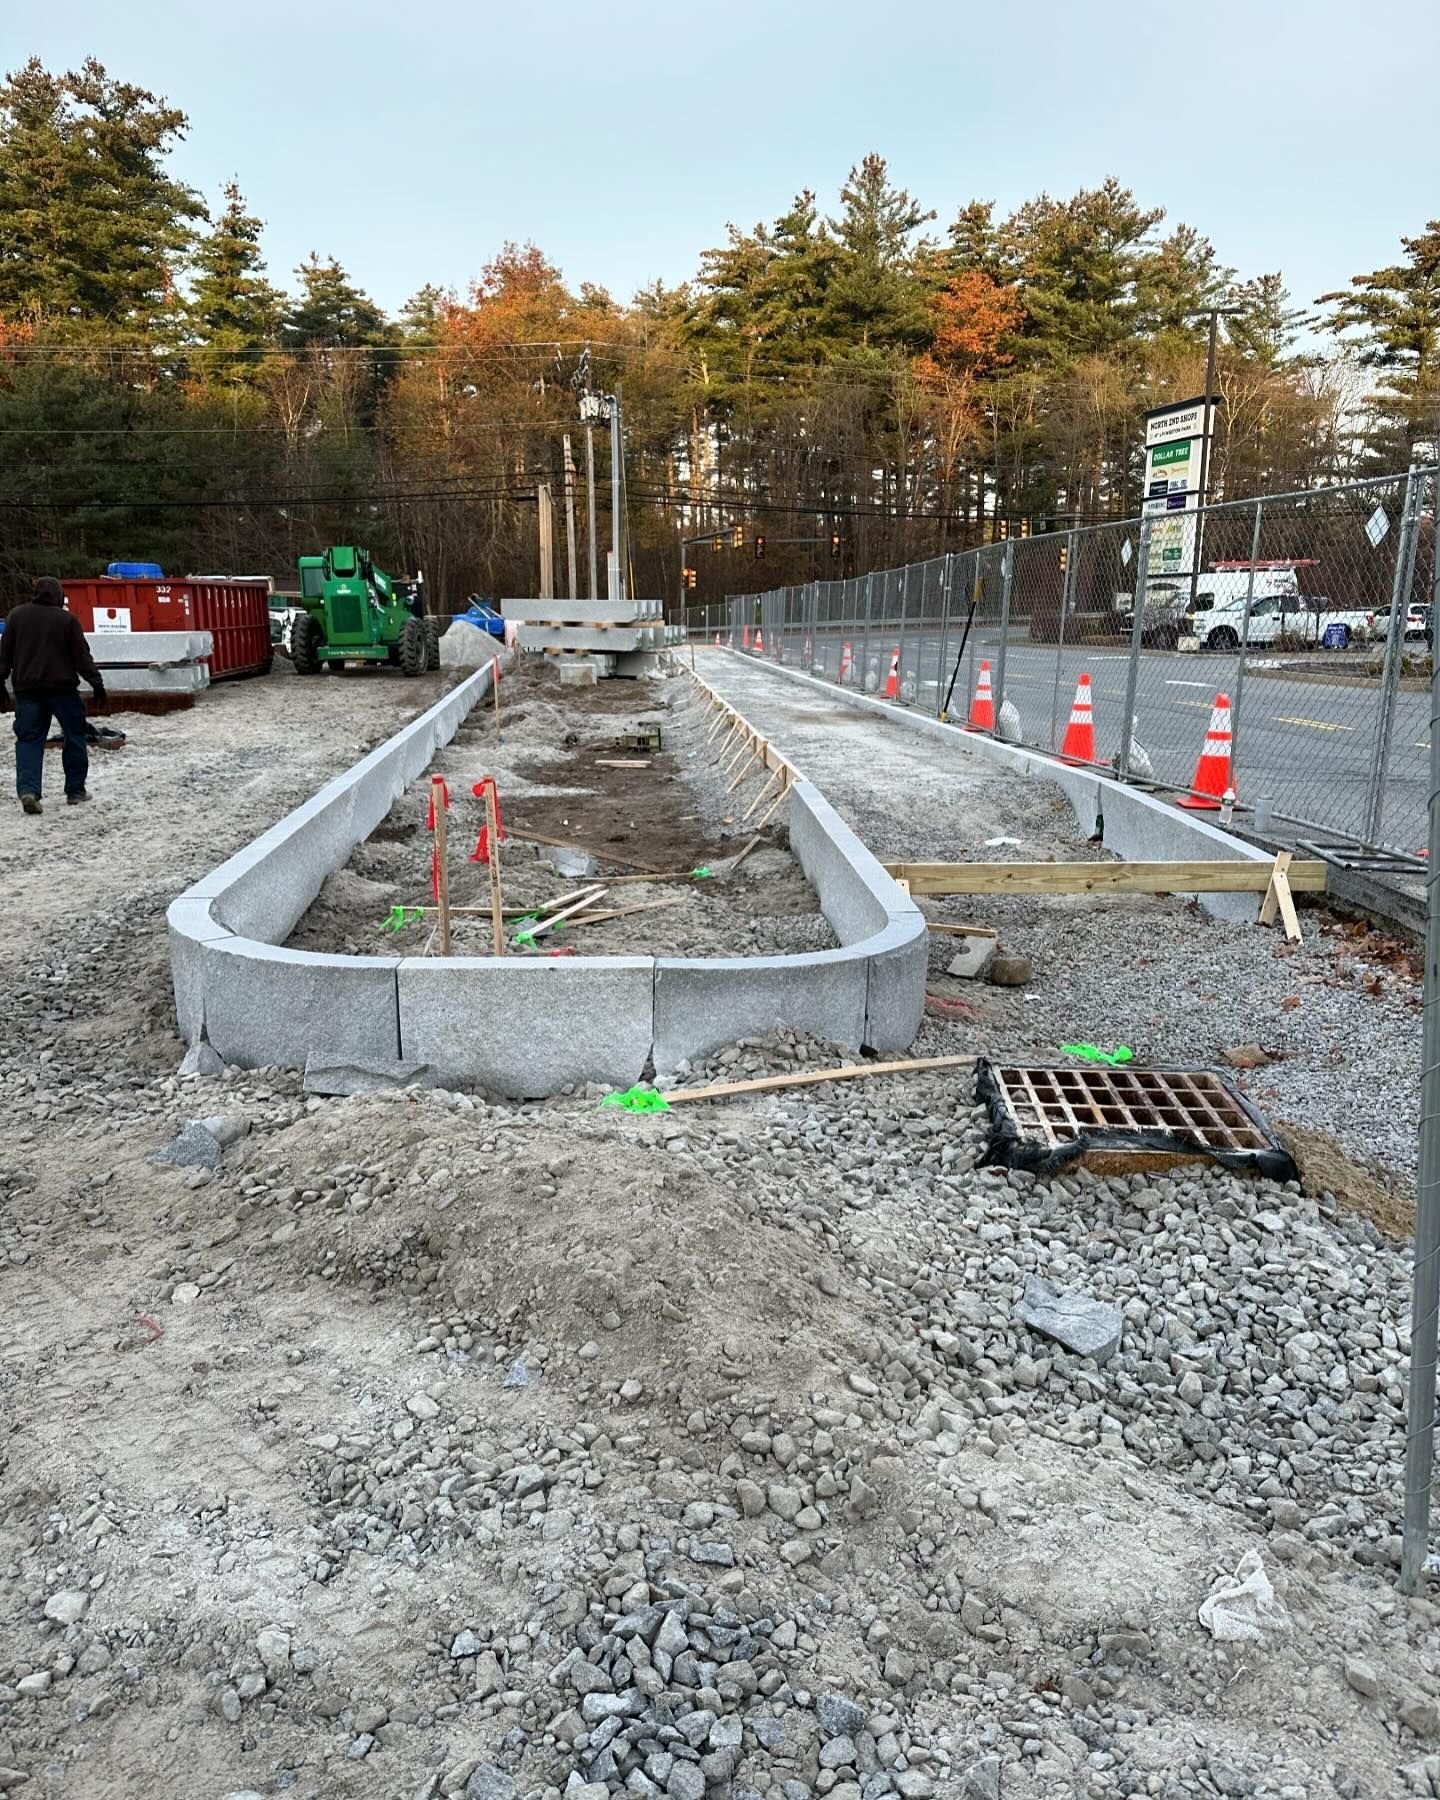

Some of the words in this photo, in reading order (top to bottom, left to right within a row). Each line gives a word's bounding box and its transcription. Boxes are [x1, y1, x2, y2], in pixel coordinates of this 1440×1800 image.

[1150, 419, 1168, 431] NORTH
[1180, 411, 1198, 423] SHOPS
[1153, 450, 1174, 461] DOLLAR
[1175, 446, 1189, 457] TREE
[155, 585, 172, 593] 332
